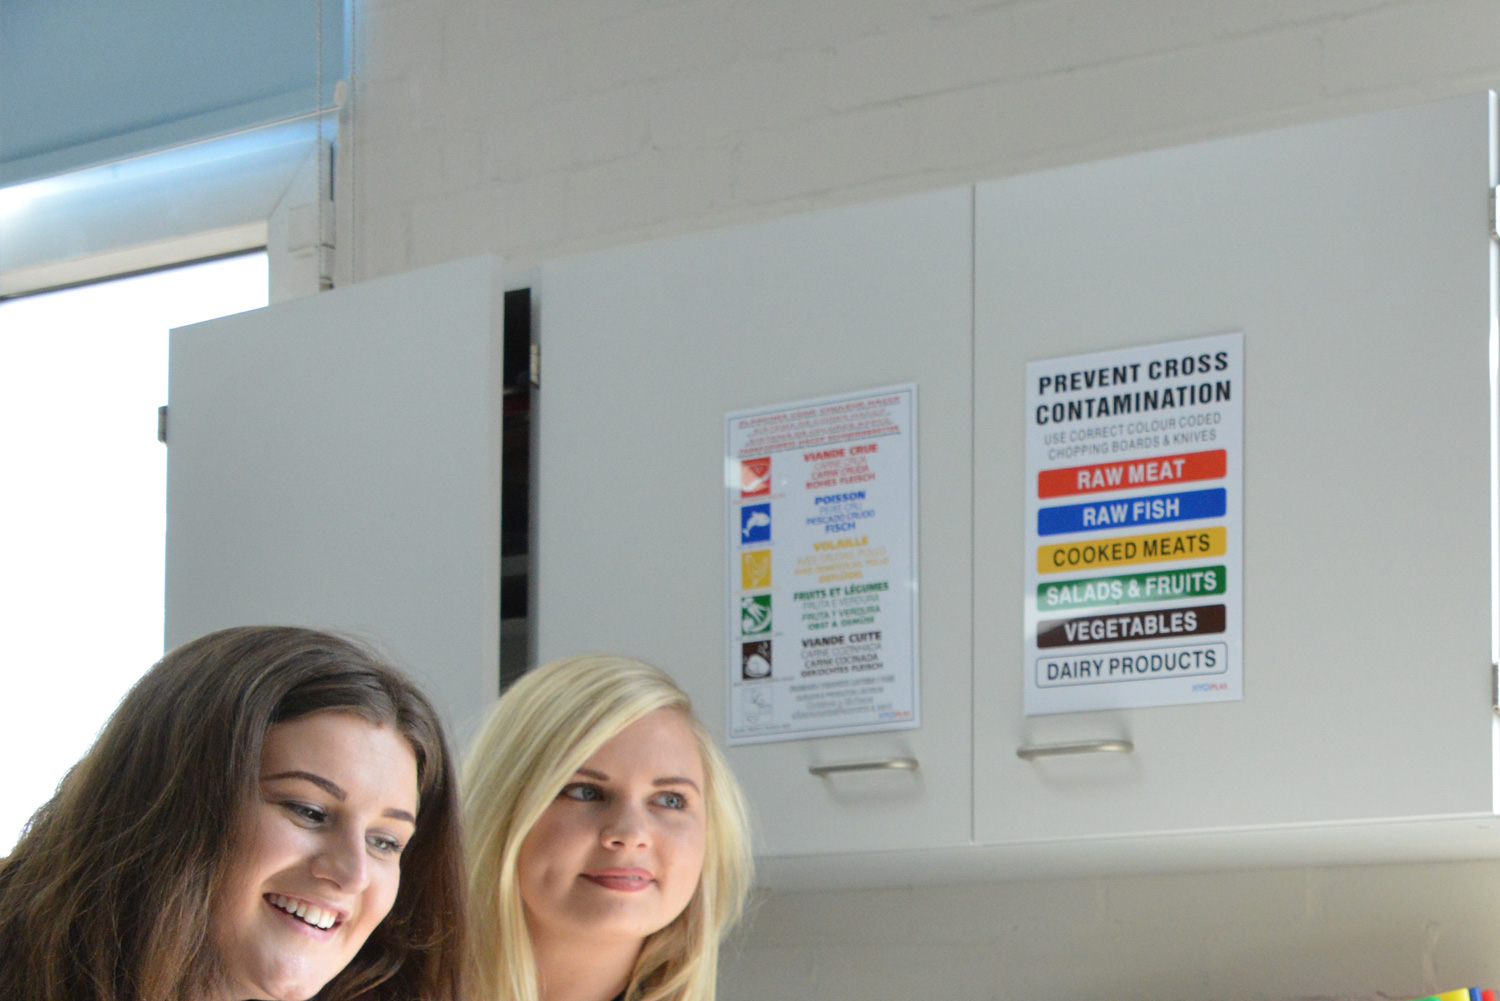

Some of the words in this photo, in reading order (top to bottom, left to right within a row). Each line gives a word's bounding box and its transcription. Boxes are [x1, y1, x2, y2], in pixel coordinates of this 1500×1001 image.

[1038, 363, 1141, 395] PREVENT
[1147, 351, 1229, 381] CROSS
[1036, 380, 1232, 426] CONTAMINATION
[1044, 431, 1067, 446] USE
[1069, 423, 1125, 443] CORRECT
[1127, 417, 1176, 435] COLOUR
[1179, 412, 1222, 429] CODED
[1048, 442, 1110, 461] CHOPPING
[1111, 435, 1161, 452] BOARDS
[1163, 433, 1171, 446] &
[1172, 428, 1217, 445] KNIVES
[803, 448, 845, 463] VIANDE
[849, 443, 878, 456] CRUE
[1077, 466, 1124, 490] RAW
[1128, 458, 1187, 485] MEAT
[814, 490, 867, 506] POISSON
[1083, 501, 1129, 527] RAW
[1133, 498, 1180, 521] FISH
[1053, 541, 1137, 567] COOKED
[1143, 533, 1210, 557] MEATS
[793, 588, 827, 601] FRUITS
[829, 587, 841, 598] ET
[844, 581, 889, 596] LÉGUMES
[1046, 580, 1123, 606] SALADS
[1128, 579, 1141, 598] &
[1145, 571, 1217, 596] FRUITS
[801, 635, 845, 649] VIANDE
[849, 631, 882, 644] CUITE
[1064, 611, 1198, 643] VEGETABLES
[1047, 659, 1104, 681] DAIRY
[1109, 650, 1216, 675] PRODUCTS
